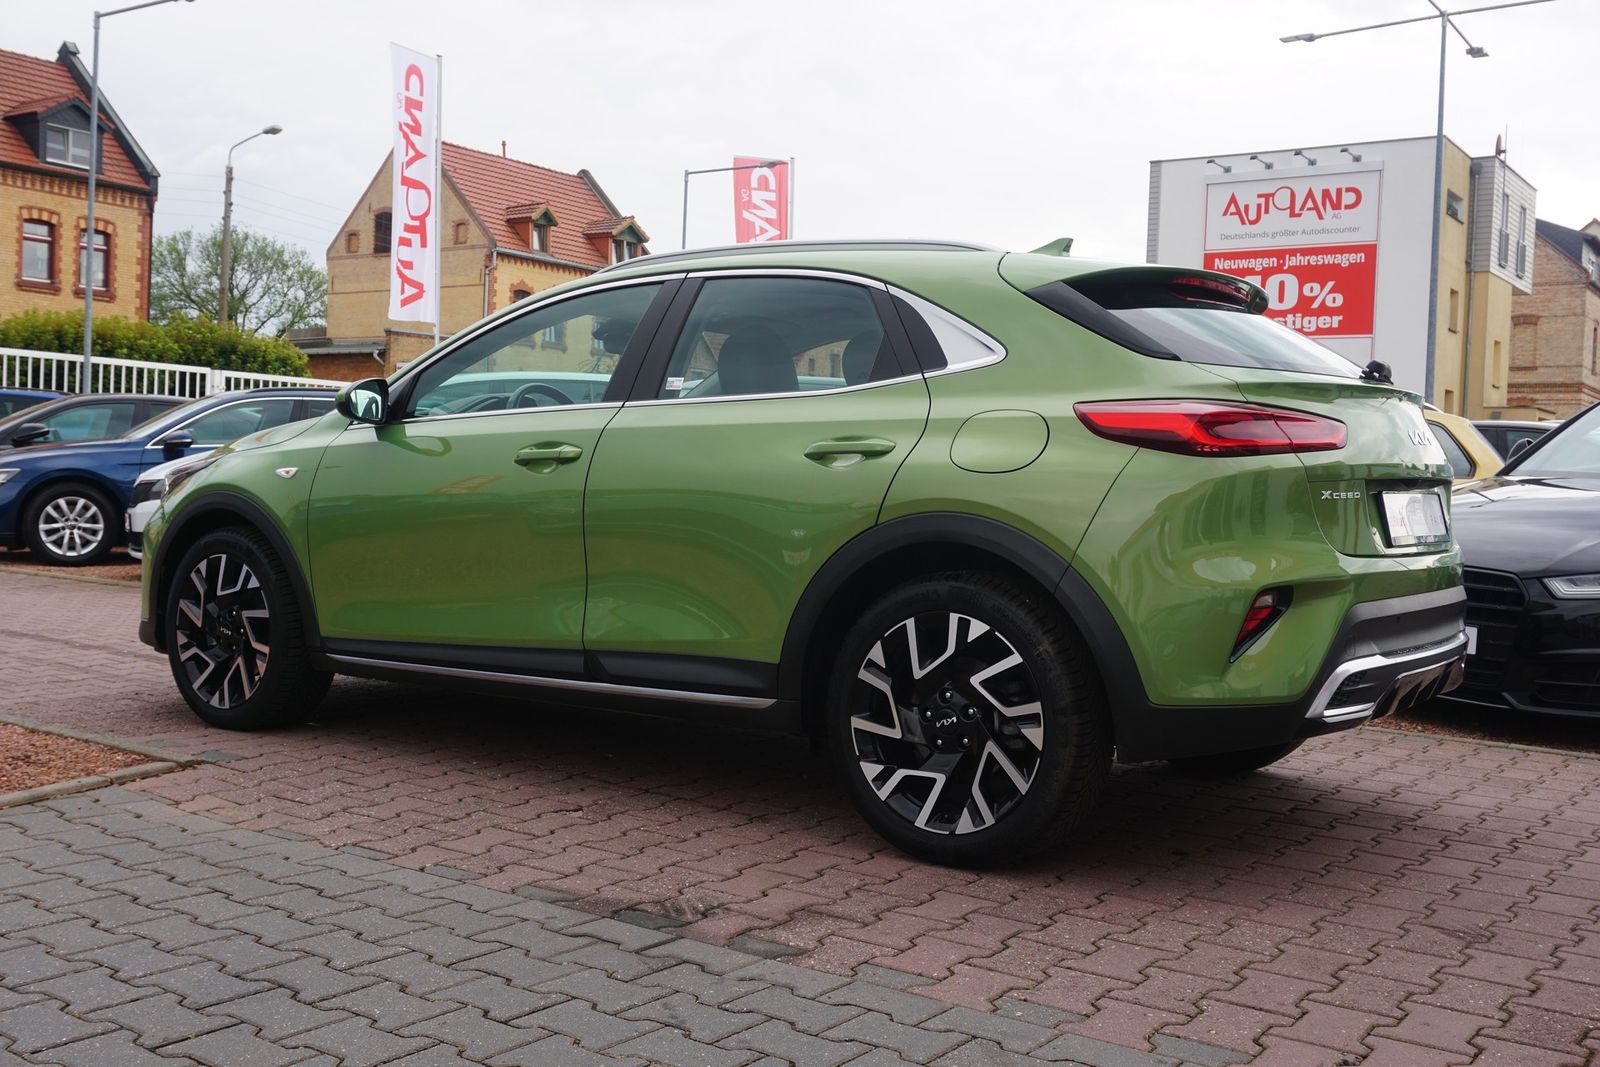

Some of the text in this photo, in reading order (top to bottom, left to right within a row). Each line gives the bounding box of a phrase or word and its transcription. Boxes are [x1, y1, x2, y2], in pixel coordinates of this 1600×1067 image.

[1222, 185, 1363, 226] AUTOLAND
[1220, 225, 1361, 241] Deutschlands größter Autodiscounter
[1214, 252, 1365, 271] Neuwagen Jahreswagen
